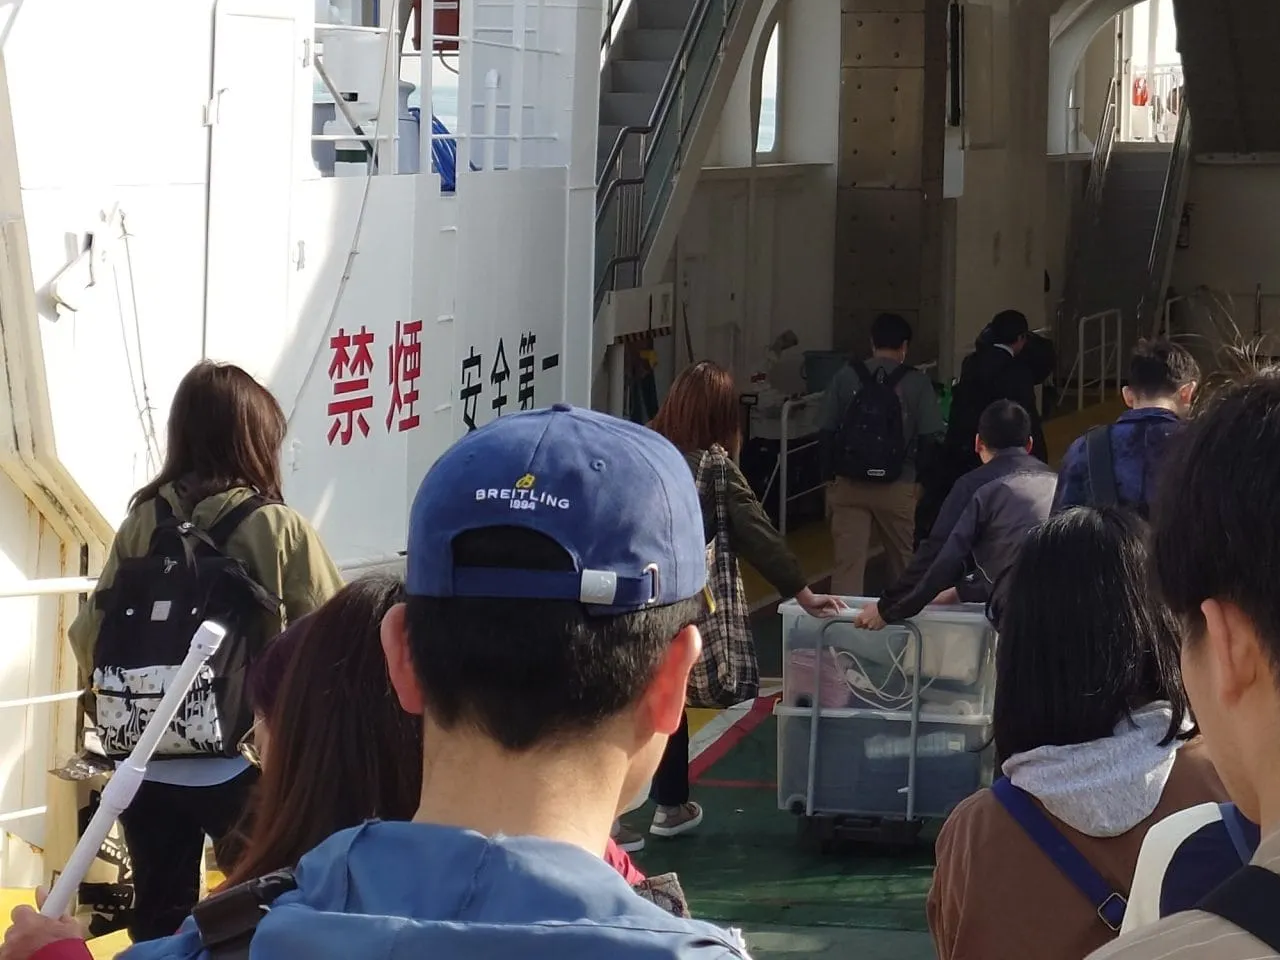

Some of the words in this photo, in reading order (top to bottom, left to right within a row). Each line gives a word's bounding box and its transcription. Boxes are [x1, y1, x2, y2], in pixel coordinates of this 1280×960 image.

[326, 320, 424, 446] 禁煙
[459, 329, 560, 432] 安全第一
[475, 488, 570, 509] BREITLING
